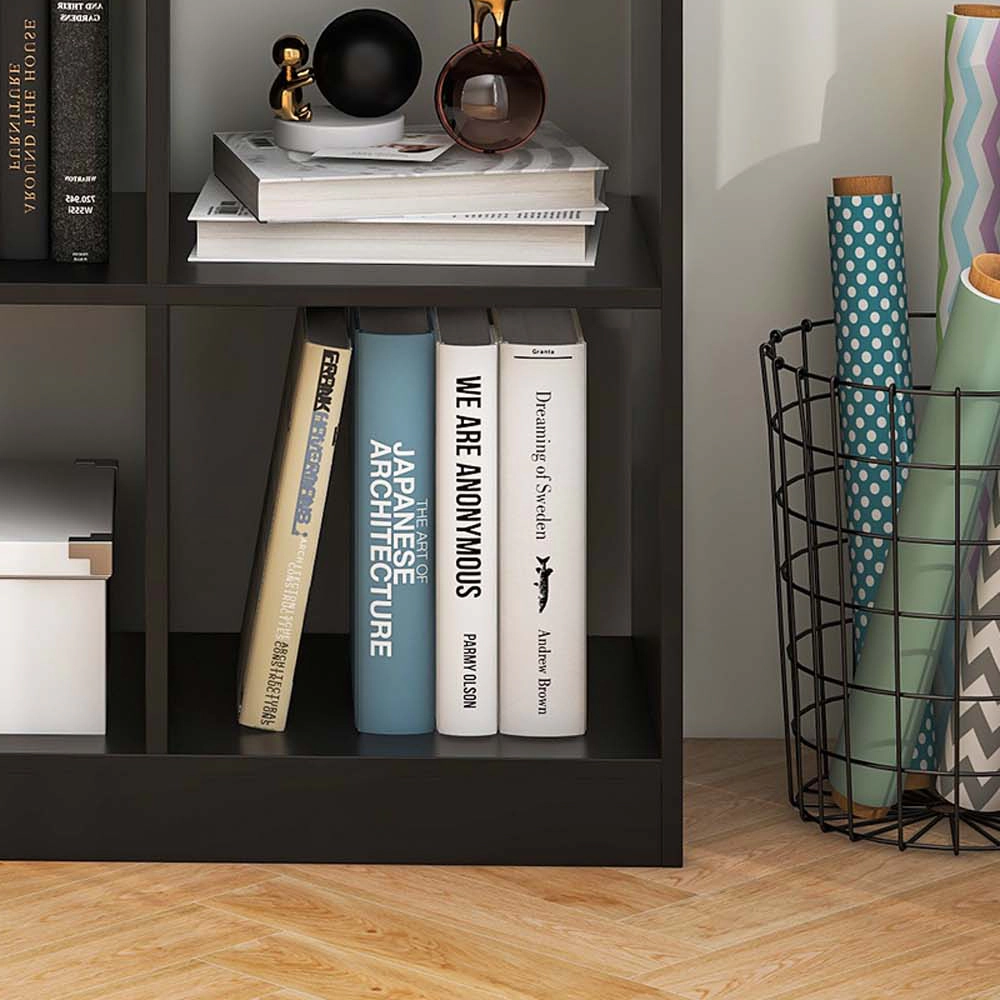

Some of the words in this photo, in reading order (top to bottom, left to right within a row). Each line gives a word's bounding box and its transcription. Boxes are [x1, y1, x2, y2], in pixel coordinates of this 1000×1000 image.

[456, 375, 481, 408] WE
[456, 414, 481, 456] ARE
[531, 391, 552, 461] Dreaming
[535, 464, 552, 483] of
[393, 442, 415, 584] JAPANESE
[416, 499, 428, 528] THE
[456, 462, 481, 598] ANONYMOUS
[535, 484, 552, 540] Sweden
[370, 439, 392, 657] ARCHITECTURE
[416, 529, 428, 560] ART
[416, 563, 428, 584] OF
[463, 633, 477, 674] PARMY
[538, 629, 551, 674] Andrew
[463, 674, 477, 710] OLSON
[538, 678, 551, 715] Brown
